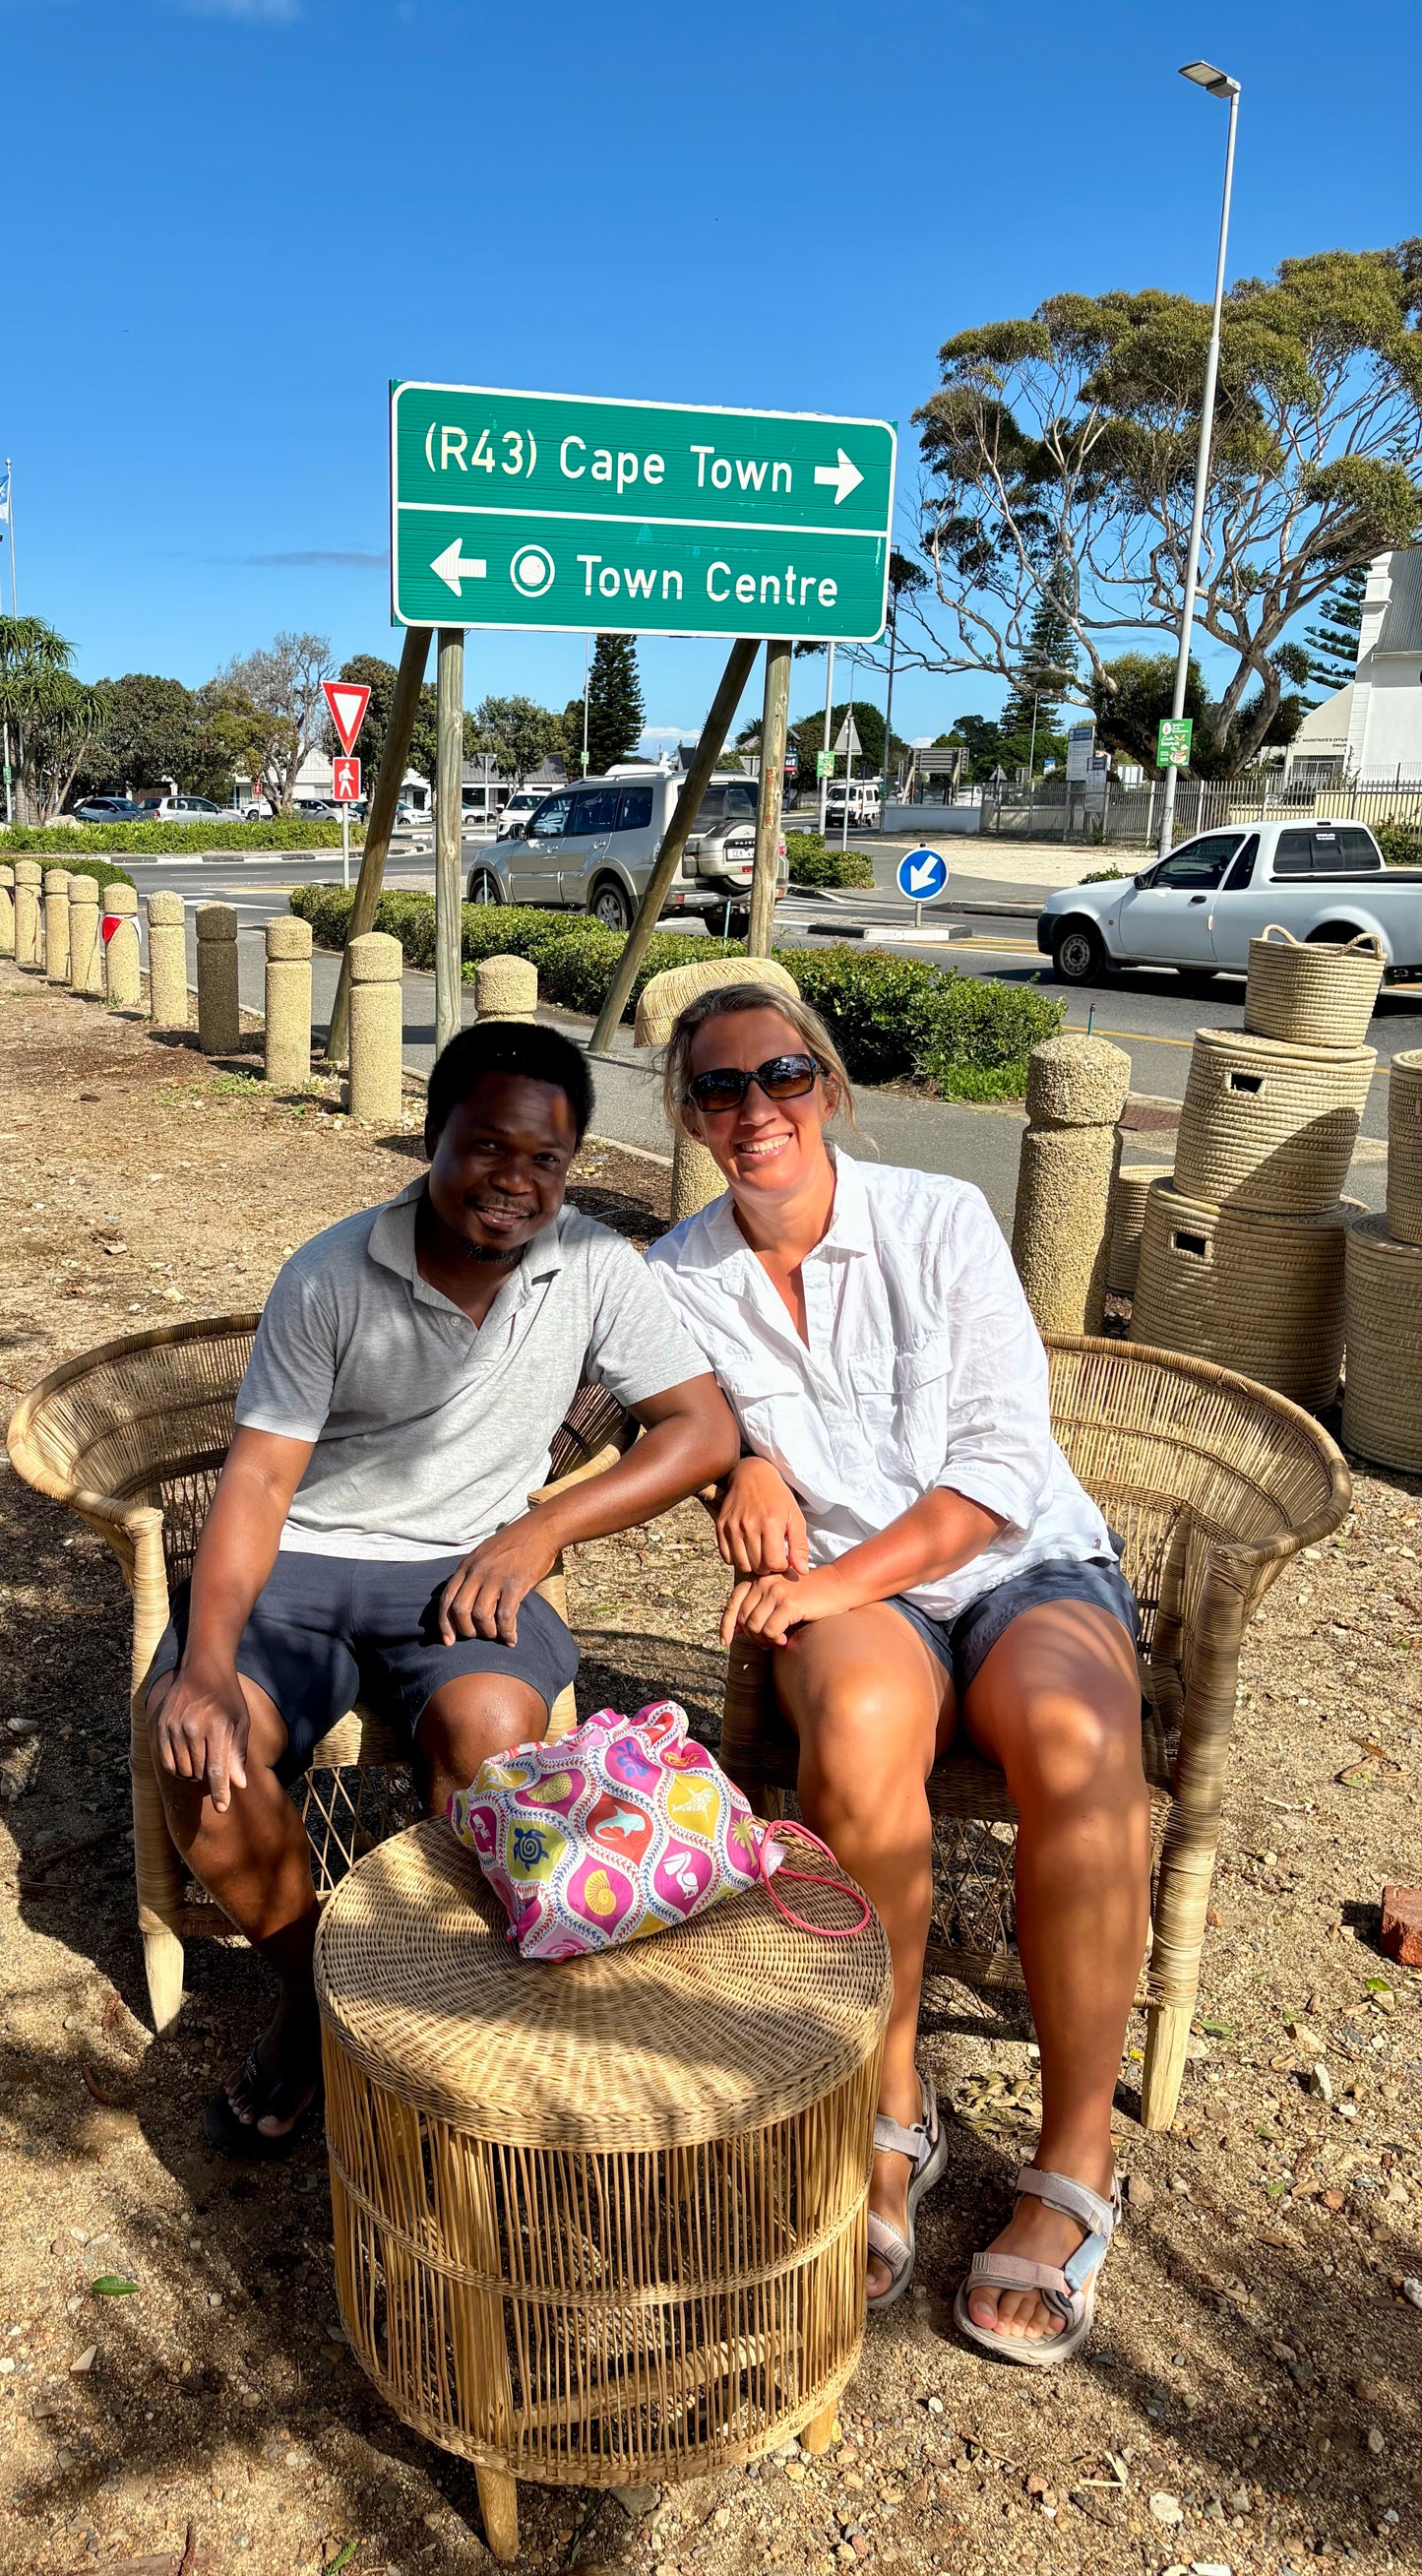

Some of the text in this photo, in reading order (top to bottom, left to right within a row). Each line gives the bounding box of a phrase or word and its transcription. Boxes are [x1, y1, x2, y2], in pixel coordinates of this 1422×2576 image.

[424, 422, 792, 494] (R43) Cape Town
[576, 554, 837, 607] Town Centre
